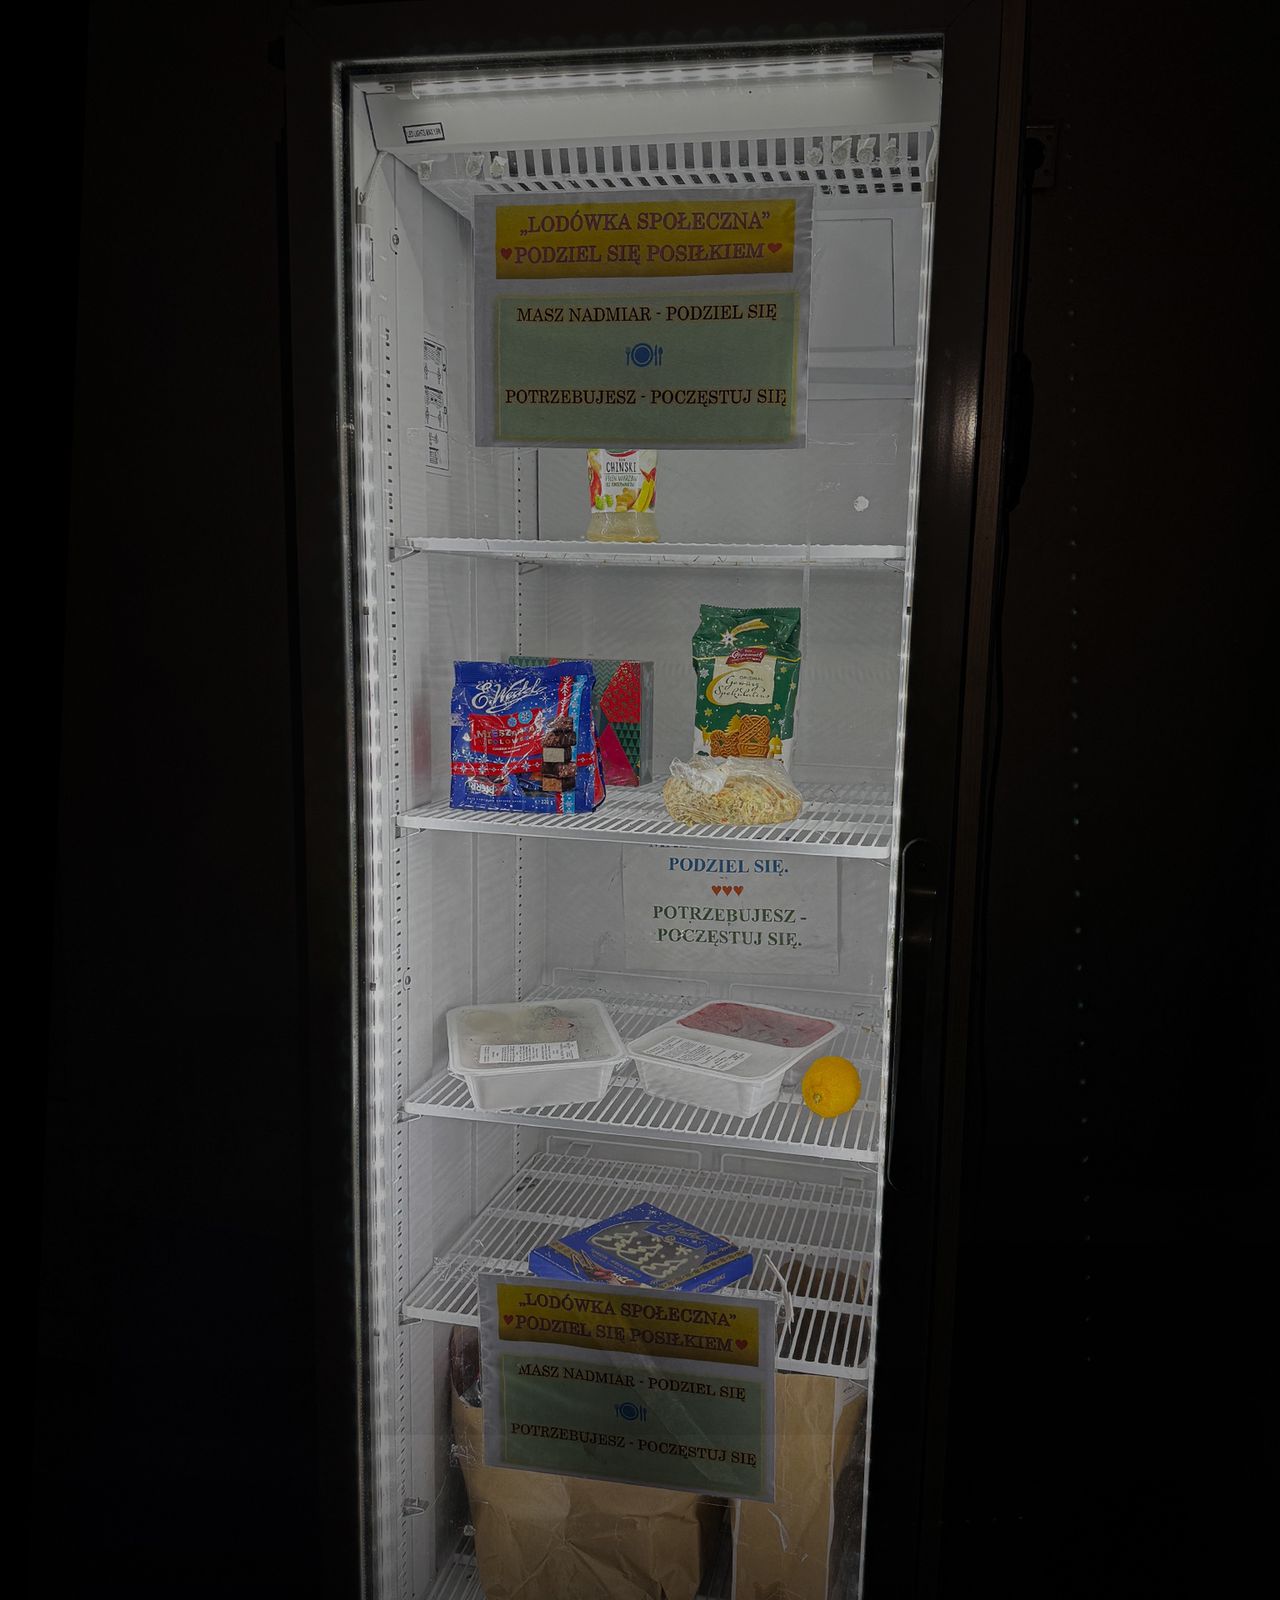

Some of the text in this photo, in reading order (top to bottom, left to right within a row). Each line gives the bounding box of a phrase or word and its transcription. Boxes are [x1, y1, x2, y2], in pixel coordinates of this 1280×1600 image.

[519, 209, 771, 237] „LODÓWKA SPOŁECZNA”
[514, 242, 766, 266] PODZIEL SIĘ POSIŁKIEM
[516, 307, 564, 323] MASZ
[569, 306, 652, 322] NADMIAR
[665, 304, 744, 321] PODZIEL
[747, 302, 777, 321] SIĘ
[505, 388, 637, 405] POTRZEBUJESZ
[650, 388, 753, 408] POCZĘSTUJ
[757, 388, 787, 407] SIĘ
[669, 857, 789, 877] PODZIEL SIĘ.
[653, 905, 796, 923] POTRZEBUJESZ
[656, 928, 802, 949] POCZĘSTUJ SIĘ.
[519, 1291, 737, 1328] „LODÓWKA SPOŁECZNA”
[515, 1314, 734, 1352] PODZIEL SIĘ POSIŁKIEM
[518, 1363, 560, 1379] MASZ
[563, 1367, 636, 1388] NADMIAR
[647, 1377, 716, 1397] PODZIEL
[719, 1385, 747, 1402] SIĘ
[511, 1422, 626, 1449] POTRZEBUJESZ
[638, 1438, 727, 1462] POCZĘSTUJ
[730, 1452, 758, 1469] SIĘ
